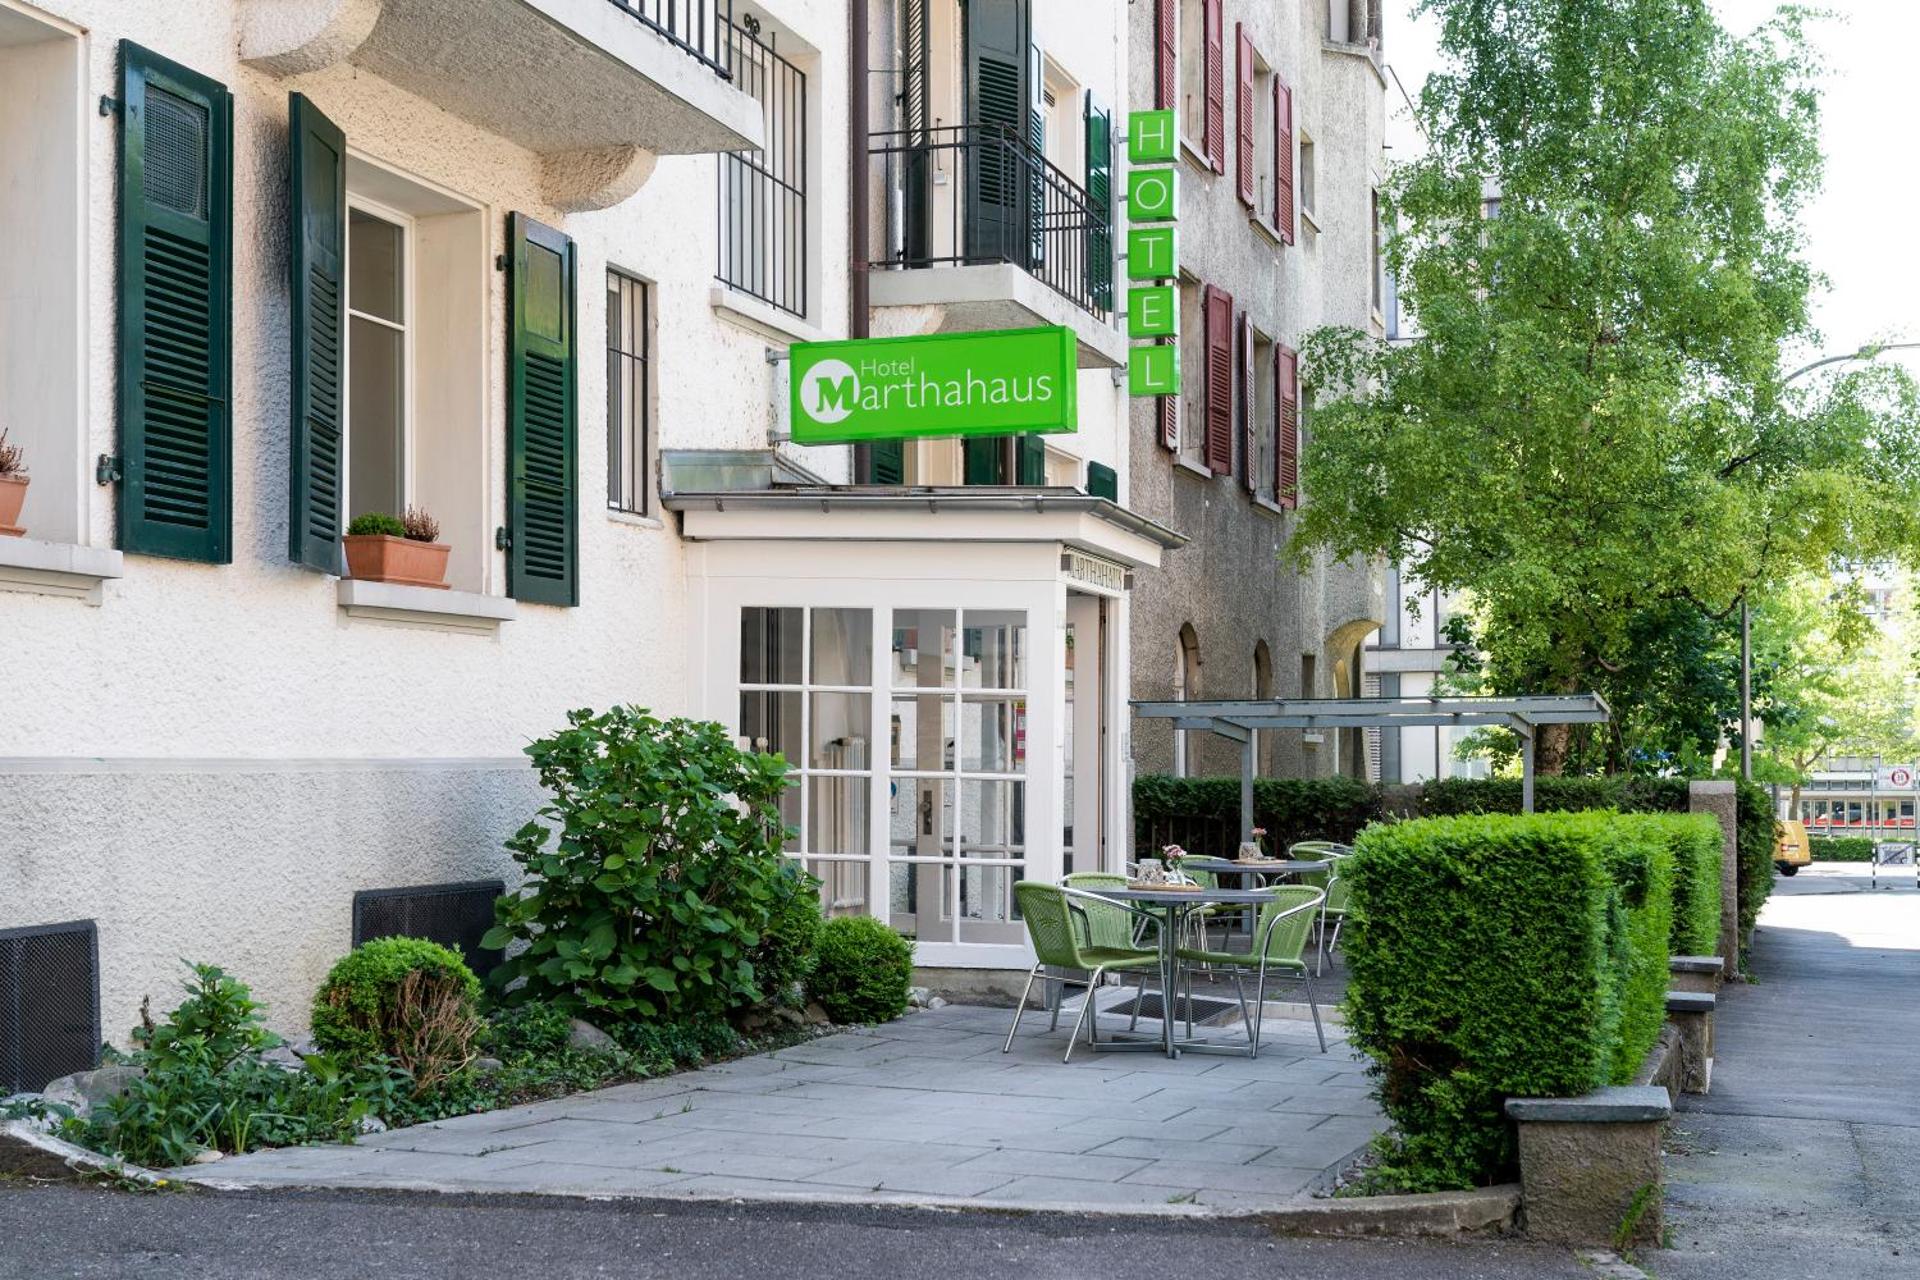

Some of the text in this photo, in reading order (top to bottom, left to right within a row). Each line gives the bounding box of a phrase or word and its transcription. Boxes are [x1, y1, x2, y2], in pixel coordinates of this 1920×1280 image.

[1136, 119, 1166, 386] HOTEL
[861, 356, 914, 376] Hotel
[815, 368, 1053, 413] Marthahaus
